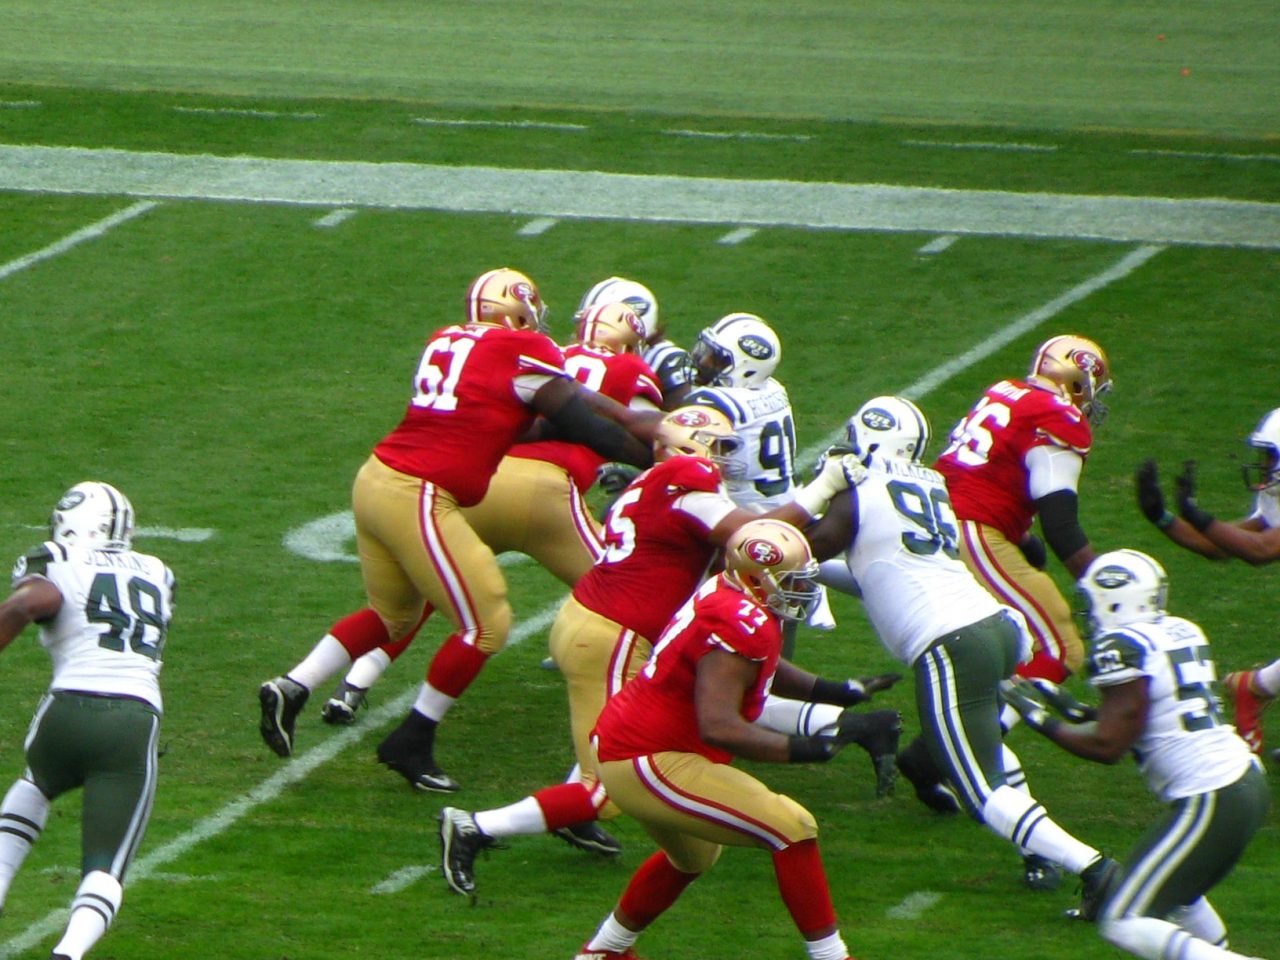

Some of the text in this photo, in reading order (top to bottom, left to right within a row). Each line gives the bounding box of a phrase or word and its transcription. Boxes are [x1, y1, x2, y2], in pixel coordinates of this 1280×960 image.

[412, 336, 476, 411] 61
[886, 479, 960, 560] 96
[86, 573, 164, 662] 48
[737, 599, 768, 627] 77
